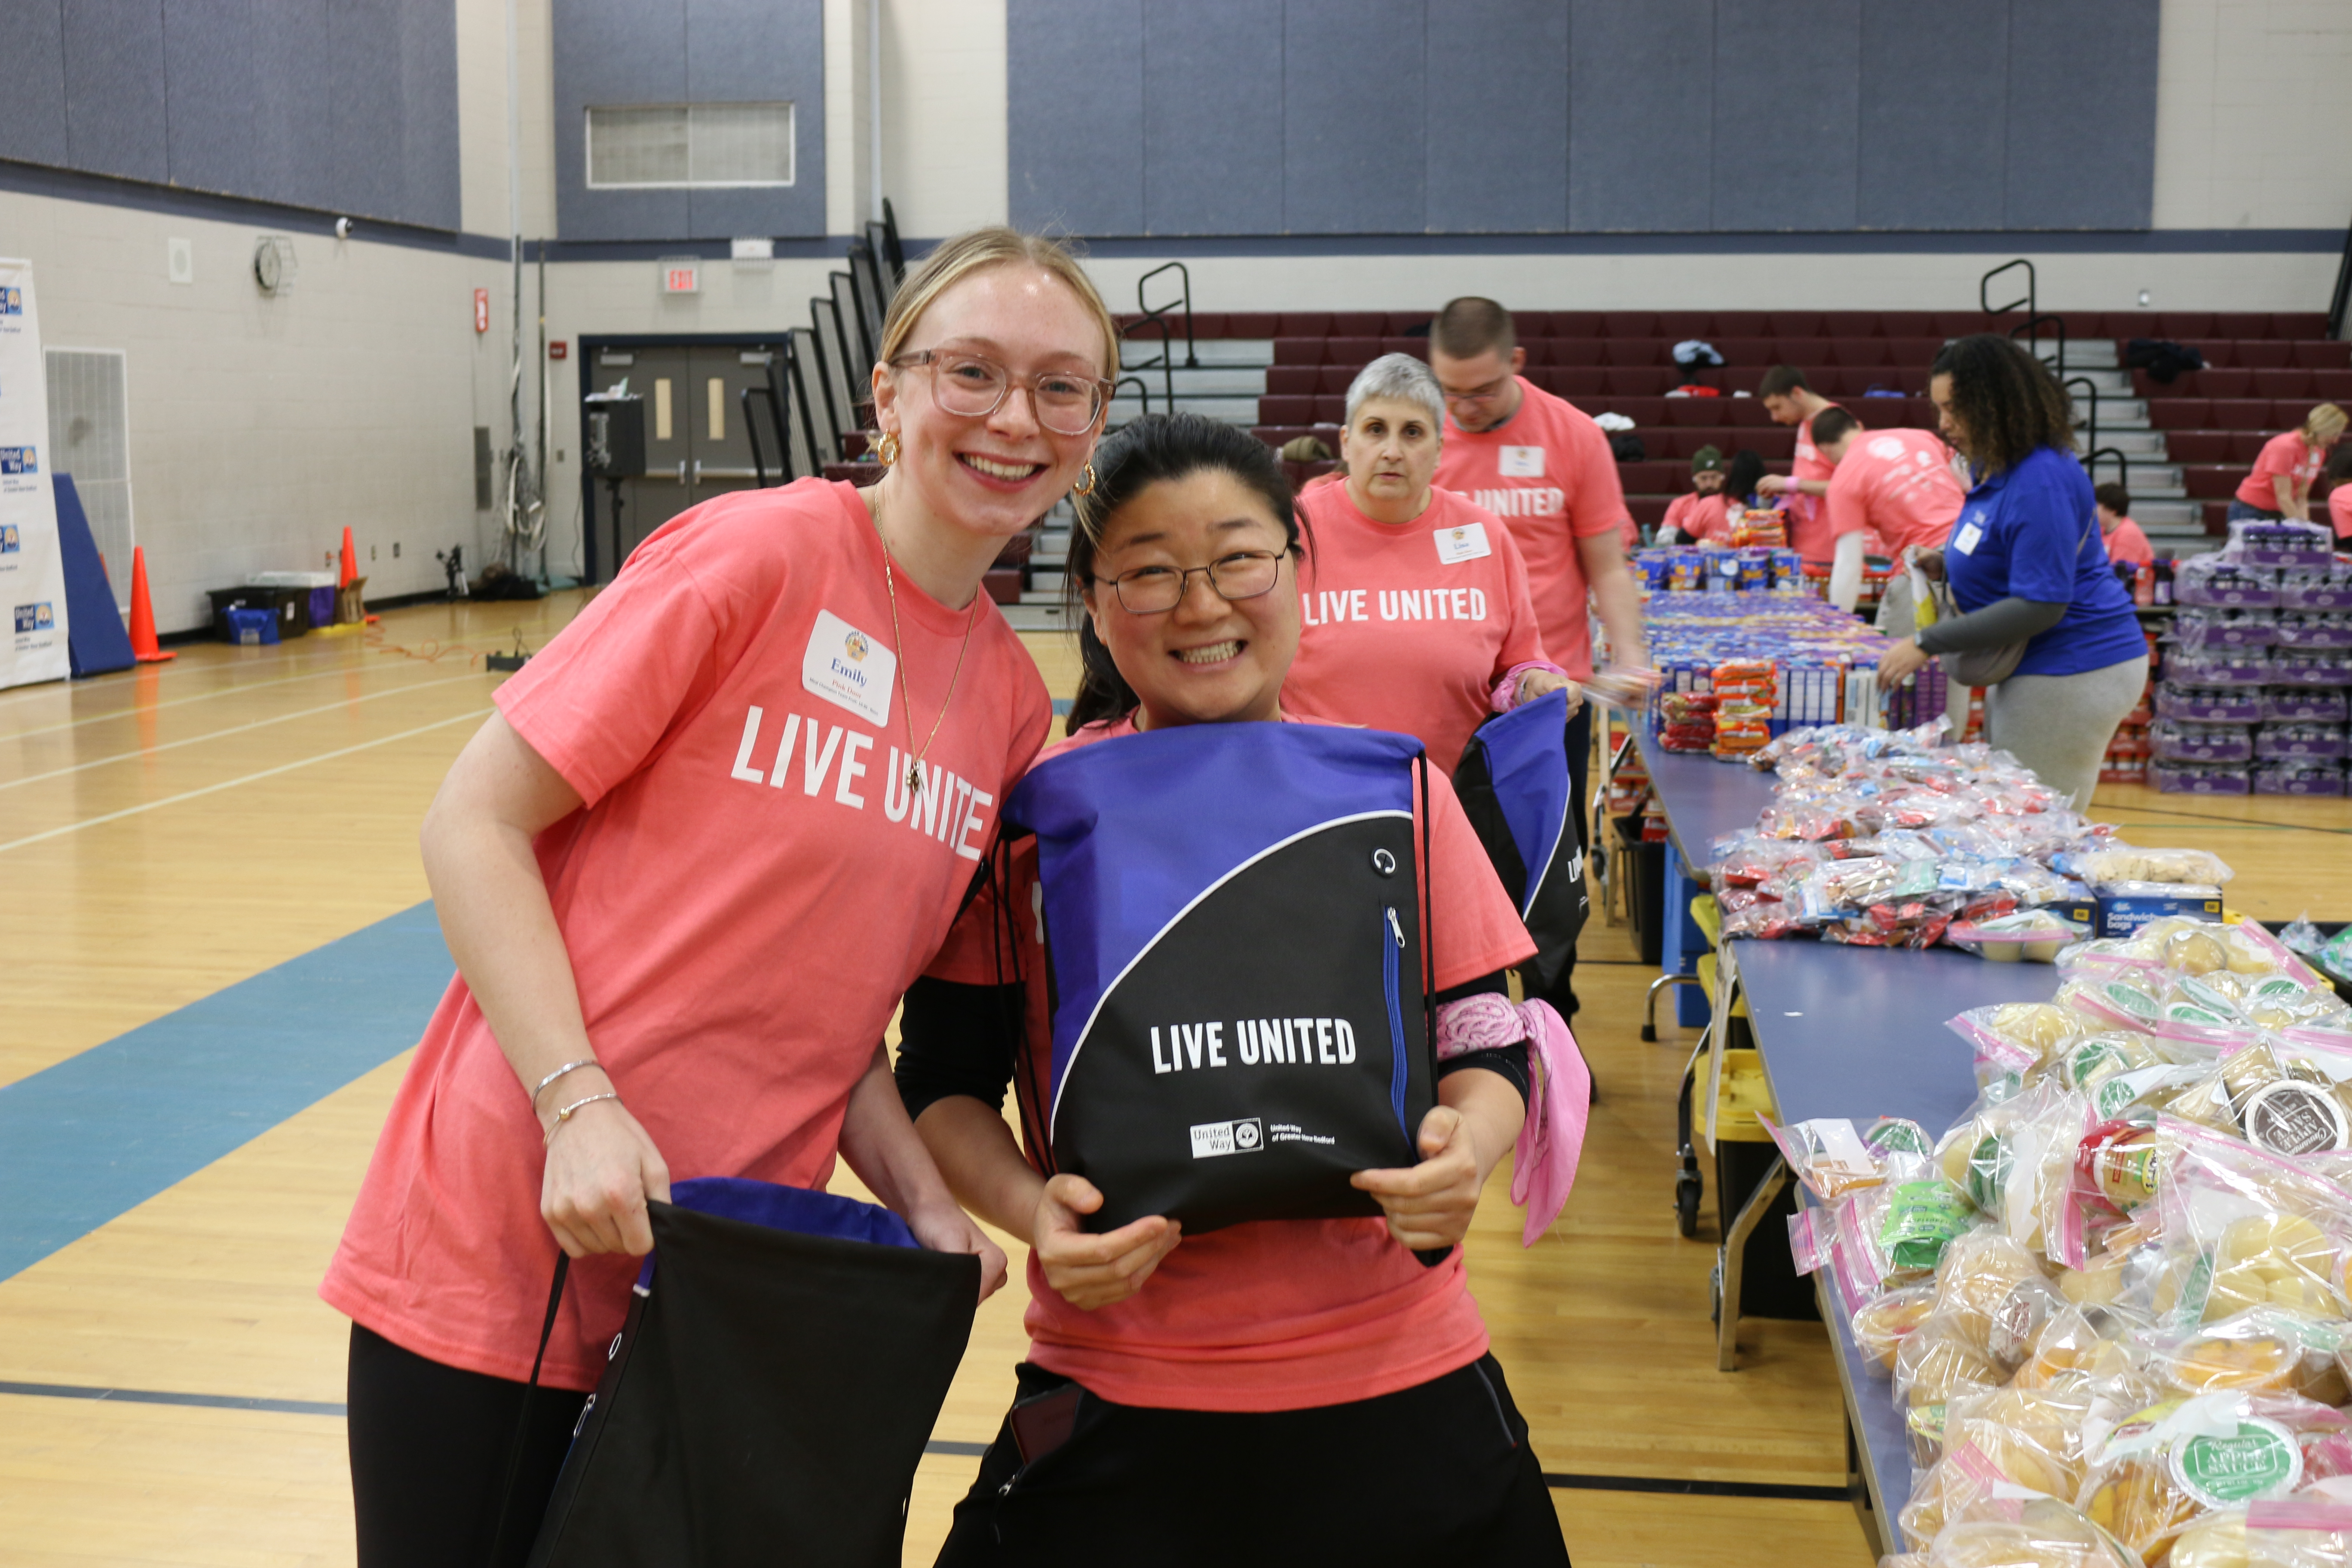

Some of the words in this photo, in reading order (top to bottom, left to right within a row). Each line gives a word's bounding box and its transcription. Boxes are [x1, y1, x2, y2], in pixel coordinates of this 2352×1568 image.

[1302, 589, 1369, 626] LIVE
[1378, 588, 1486, 621] UNITED
[831, 657, 867, 687] Emily
[832, 679, 845, 691] Pink
[847, 684, 861, 699] Door
[731, 705, 873, 809] LIVE
[2107, 912, 2155, 922] Sandwich
[2107, 919, 2132, 931] bags
[1150, 1021, 1227, 1074] LIVE
[1236, 1018, 1357, 1065] UNITED
[1193, 1126, 1230, 1140] United
[1270, 1124, 1289, 1133] United
[1289, 1124, 1302, 1134] Way
[2280, 1119, 2318, 1152] APPLE
[1209, 1139, 1231, 1151] Way
[1272, 1133, 1279, 1142] of
[1280, 1133, 1301, 1141] Greater
[1301, 1133, 1313, 1142] New
[1313, 1135, 1335, 1145] Bedford
[2208, 1438, 2260, 1452] Regular
[2207, 1450, 2267, 1463] APPLE
[2208, 1461, 2268, 1474] SAUCE
